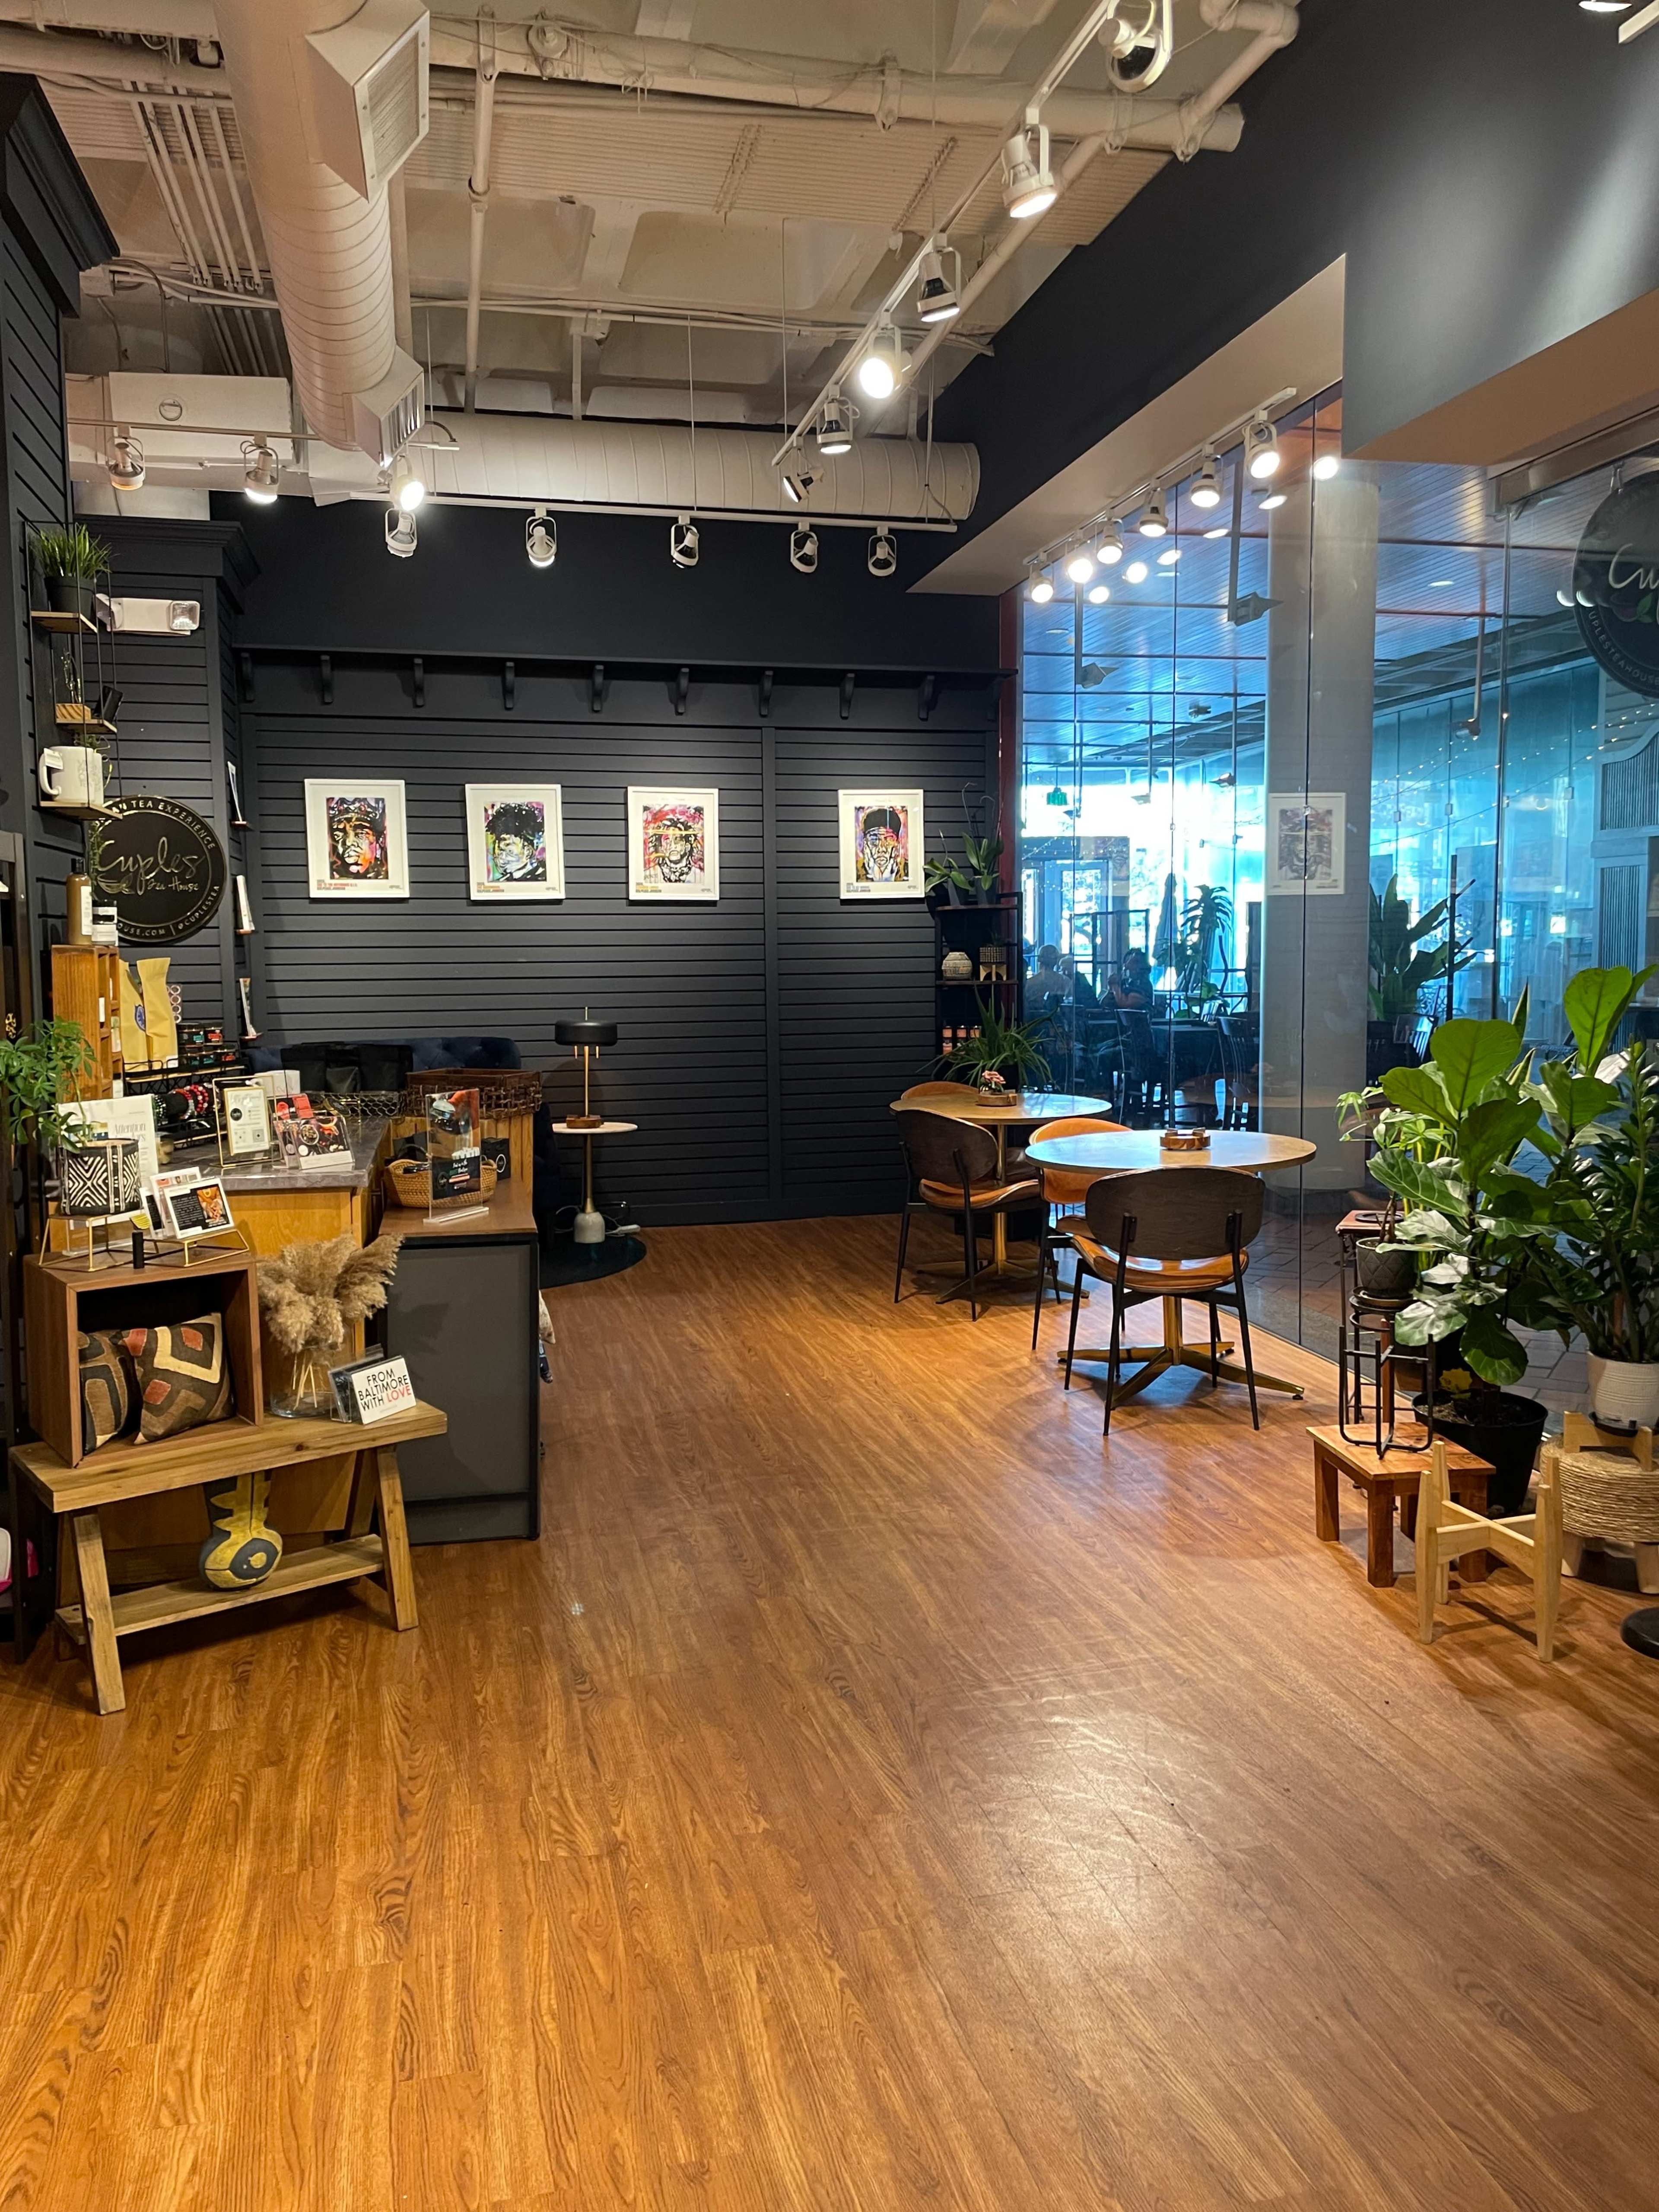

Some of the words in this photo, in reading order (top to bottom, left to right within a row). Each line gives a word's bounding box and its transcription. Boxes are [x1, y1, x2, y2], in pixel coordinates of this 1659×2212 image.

[1588, 611, 1659, 687] UPLESTEAHOUSE
[158, 802, 215, 849] EXPERIENCE
[168, 876, 199, 892] House
[117, 923, 166, 936] OUSE.COM
[178, 886, 220, 929] @CUPLESTEA
[358, 1375, 409, 1401] BALTIMORE
[367, 1368, 395, 1386] FROM
[360, 1395, 385, 1411] WITH
[387, 1385, 411, 1402] LOVE
